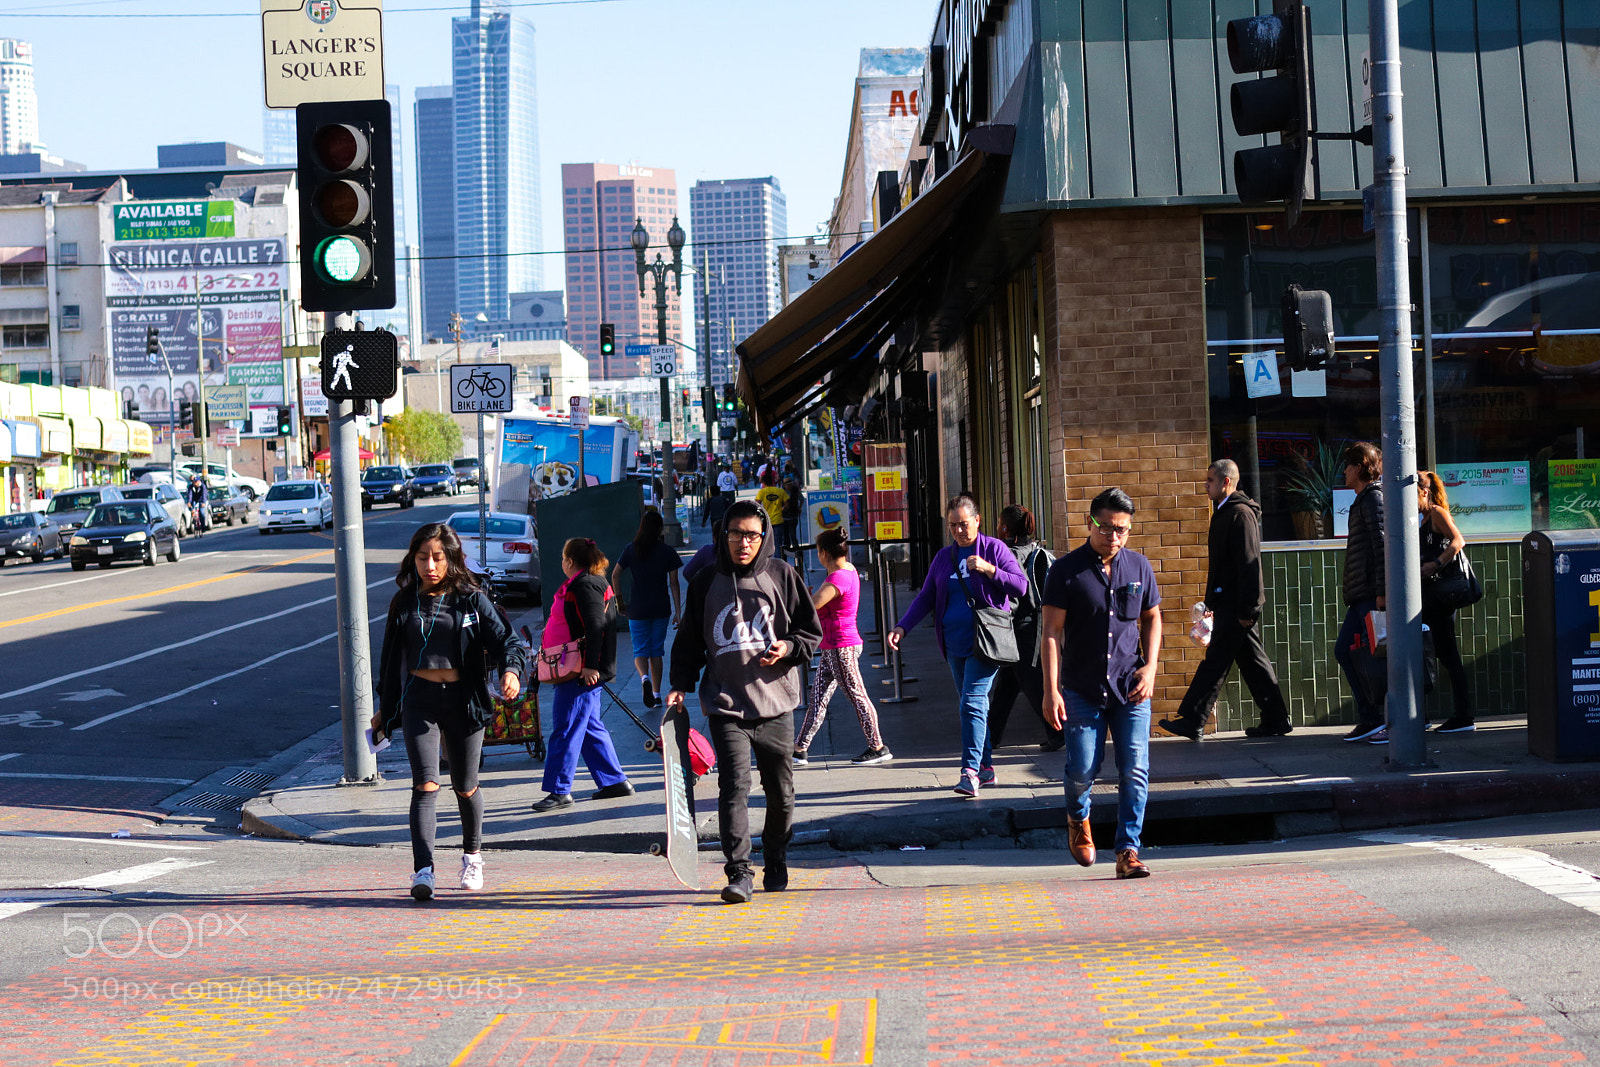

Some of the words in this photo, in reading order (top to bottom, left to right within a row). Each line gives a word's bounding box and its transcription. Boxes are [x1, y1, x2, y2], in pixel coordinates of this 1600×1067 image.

[270, 37, 375, 55] LANGER'S
[281, 61, 367, 81] SQUARE
[118, 204, 203, 219] AVAILABLE
[209, 215, 232, 223] CBRE
[121, 228, 142, 238] 213
[146, 227, 168, 238] 613
[172, 226, 201, 236] 3549
[115, 247, 194, 270] CLÍNICA
[199, 246, 258, 267] CALLE
[263, 243, 279, 265] 7
[146, 280, 174, 291] (213)
[168, 296, 219, 304] ADENTRO
[239, 294, 269, 302] Segundo
[118, 313, 168, 322] GRATIS
[227, 309, 263, 320] Dentista
[231, 367, 282, 376] FARMACIA
[654, 362, 674, 374] 30
[1254, 359, 1273, 382] A
[238, 375, 277, 384] ADENTRO
[208, 402, 243, 410] DELICATESSEN
[457, 400, 477, 411] BIKE
[480, 400, 505, 410] LANE
[1461, 469, 1483, 480] 2015
[1553, 464, 1576, 476] 2016
[882, 477, 894, 485] EBT
[883, 528, 895, 536] EBT
[1573, 694, 1600, 707] (800)
